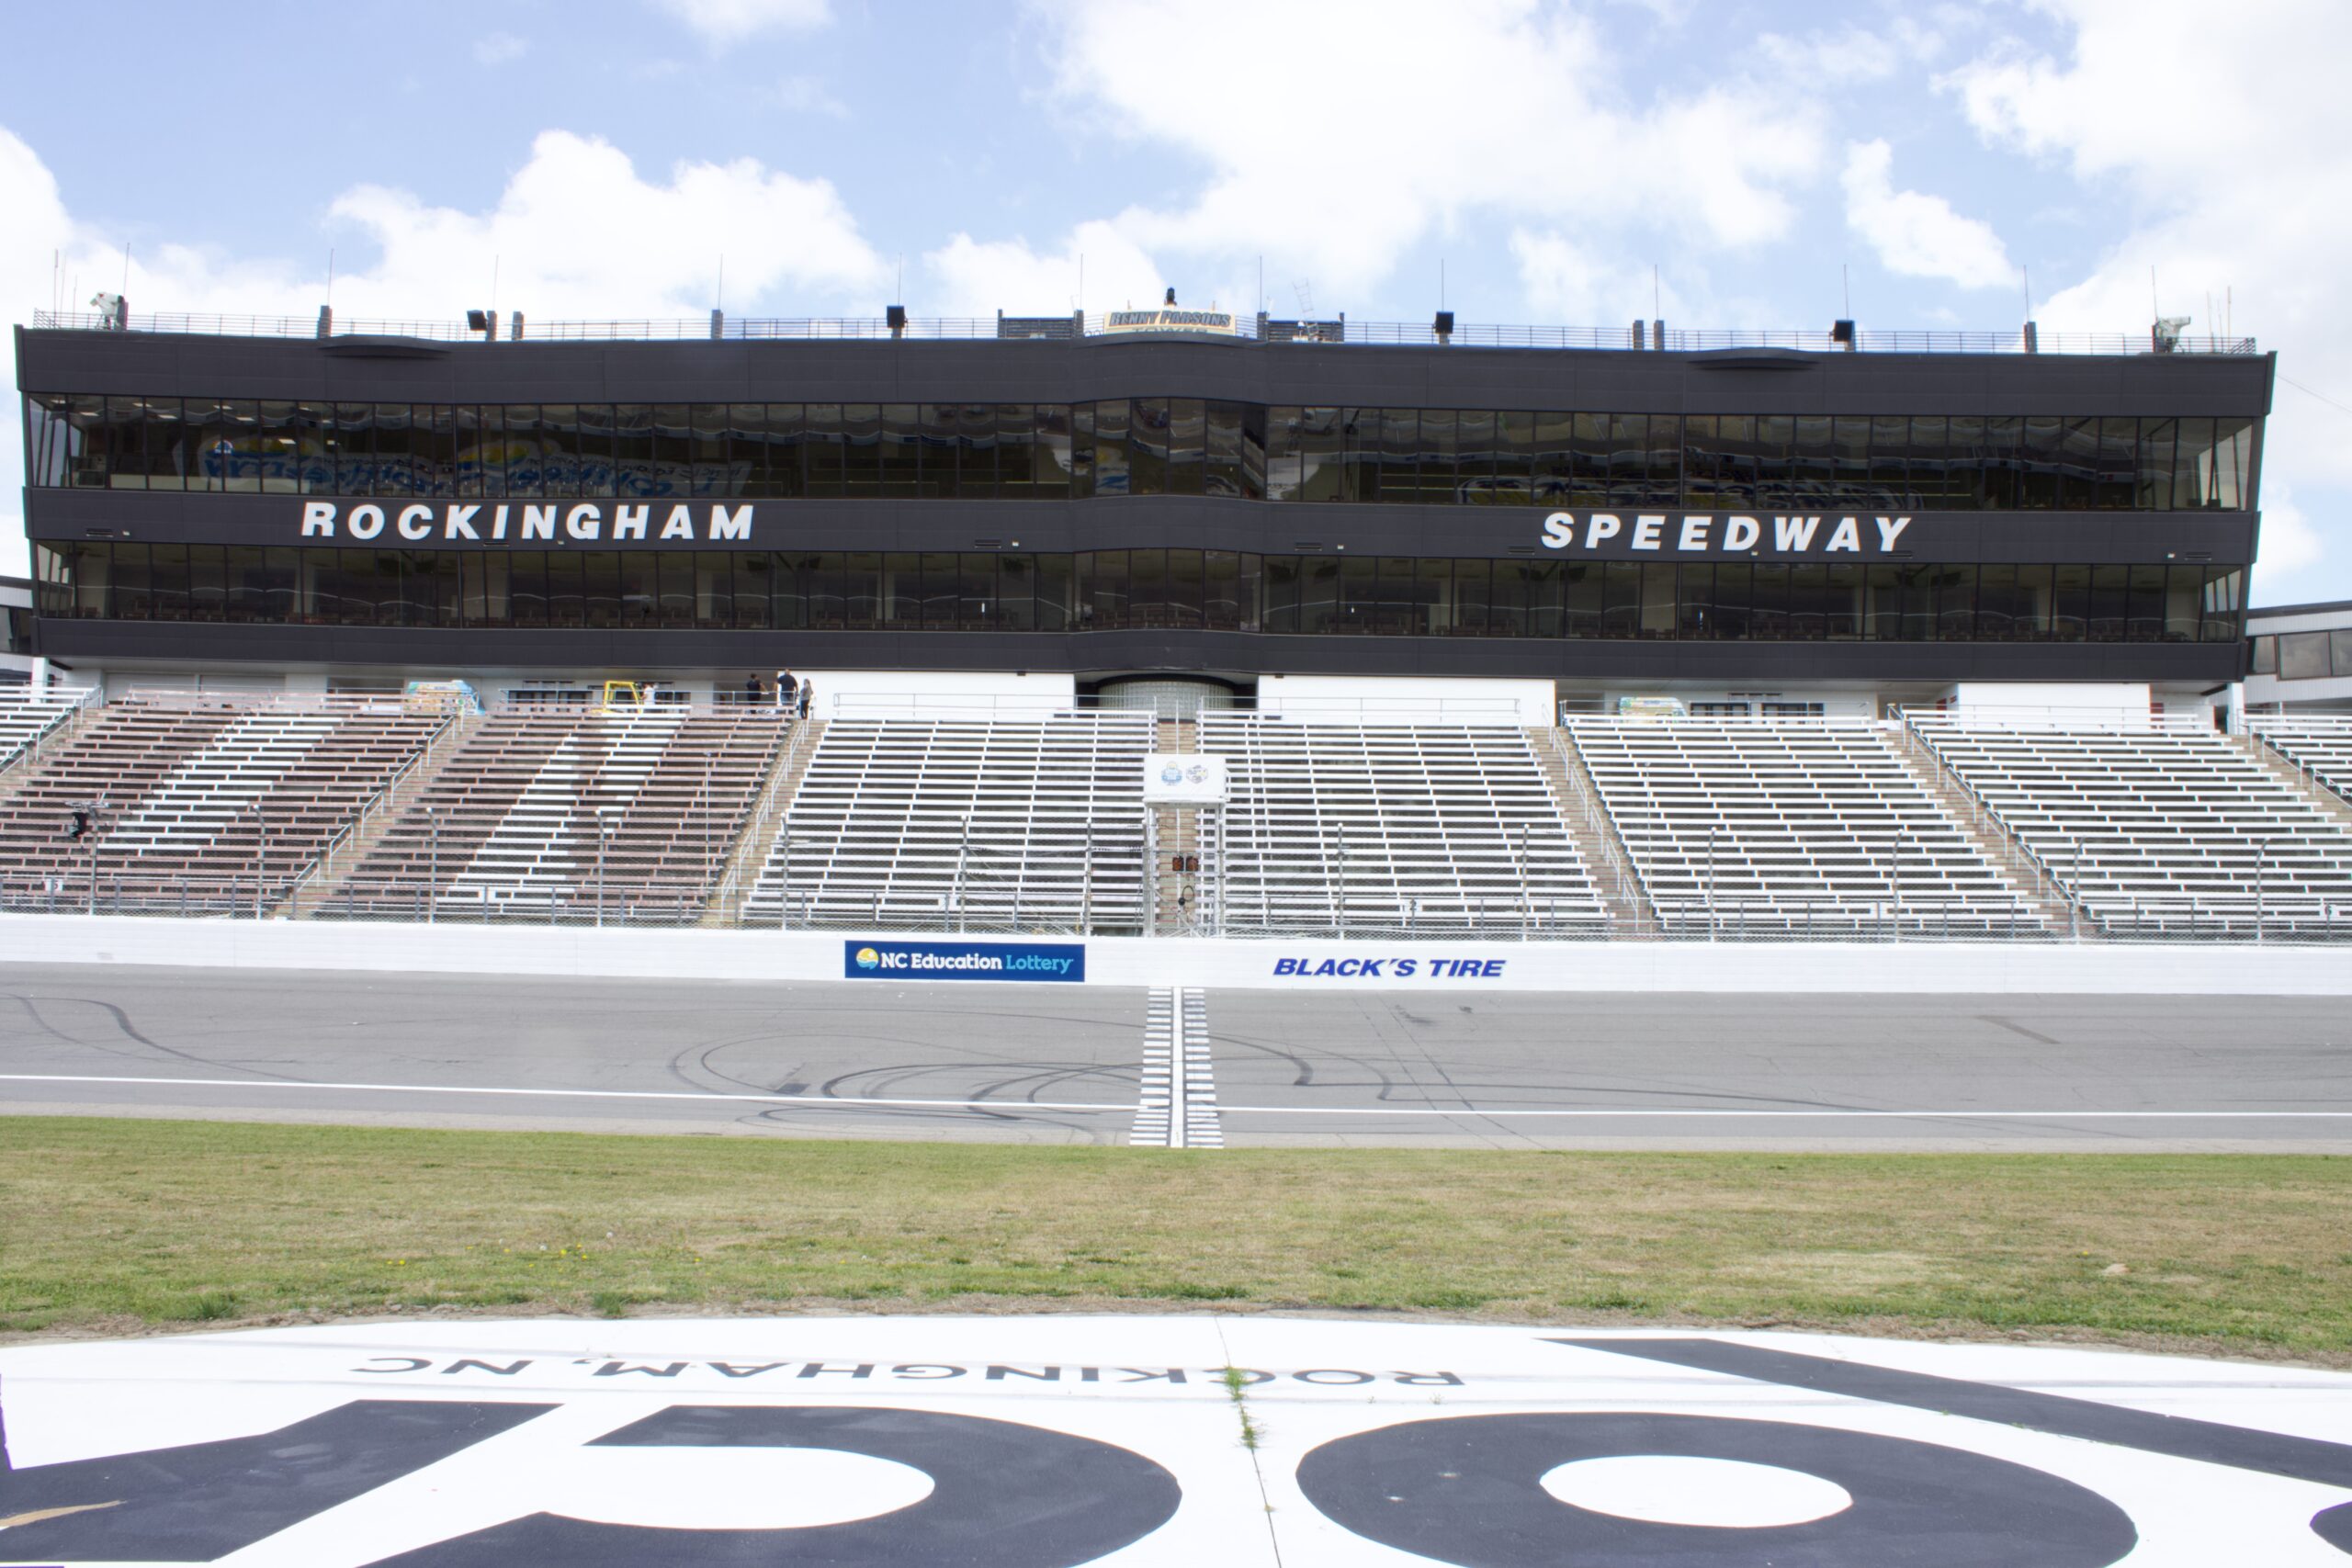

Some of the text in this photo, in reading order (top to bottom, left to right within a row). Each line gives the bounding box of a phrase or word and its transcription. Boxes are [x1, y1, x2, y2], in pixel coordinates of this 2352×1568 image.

[1109, 310, 1231, 328] BENNY PARSONS
[301, 501, 753, 540] ROCKINGHAM
[1541, 511, 1912, 553] SPEEDWAY
[880, 952, 1073, 974] NC Education Lottery
[1274, 958, 1507, 977] BLACK'S TIRE
[349, 1357, 534, 1375] NC
